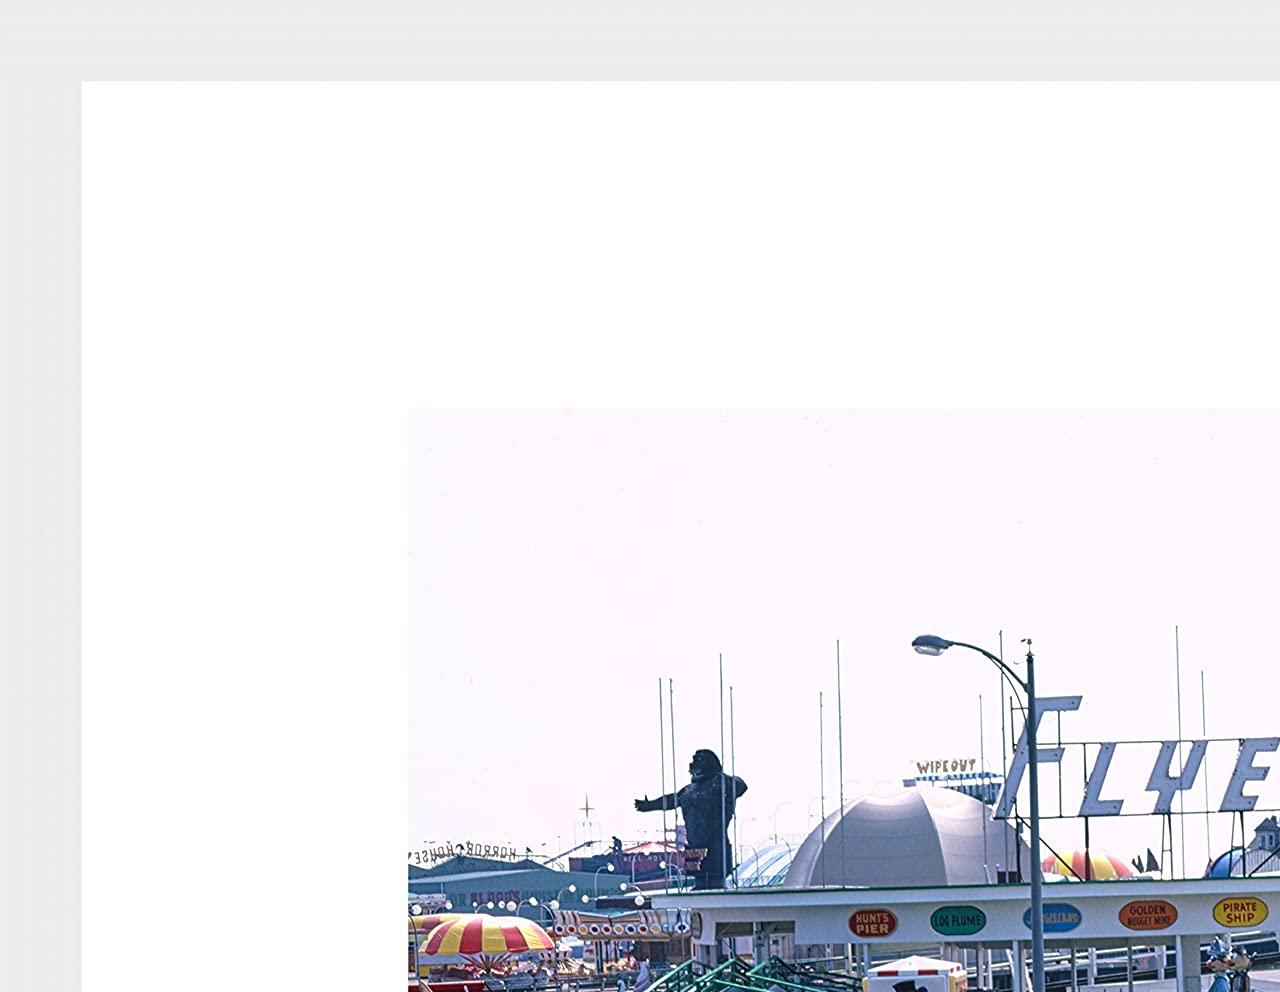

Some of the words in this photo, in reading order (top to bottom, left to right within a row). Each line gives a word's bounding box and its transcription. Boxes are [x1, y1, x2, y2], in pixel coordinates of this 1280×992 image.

[1130, 904, 1166, 915] GOLDEN
[1223, 902, 1257, 912] PIRATE
[935, 915, 949, 927] LOG
[952, 914, 981, 927] FLUME
[1226, 913, 1255, 923] SHIP
[856, 924, 889, 934] PIER
